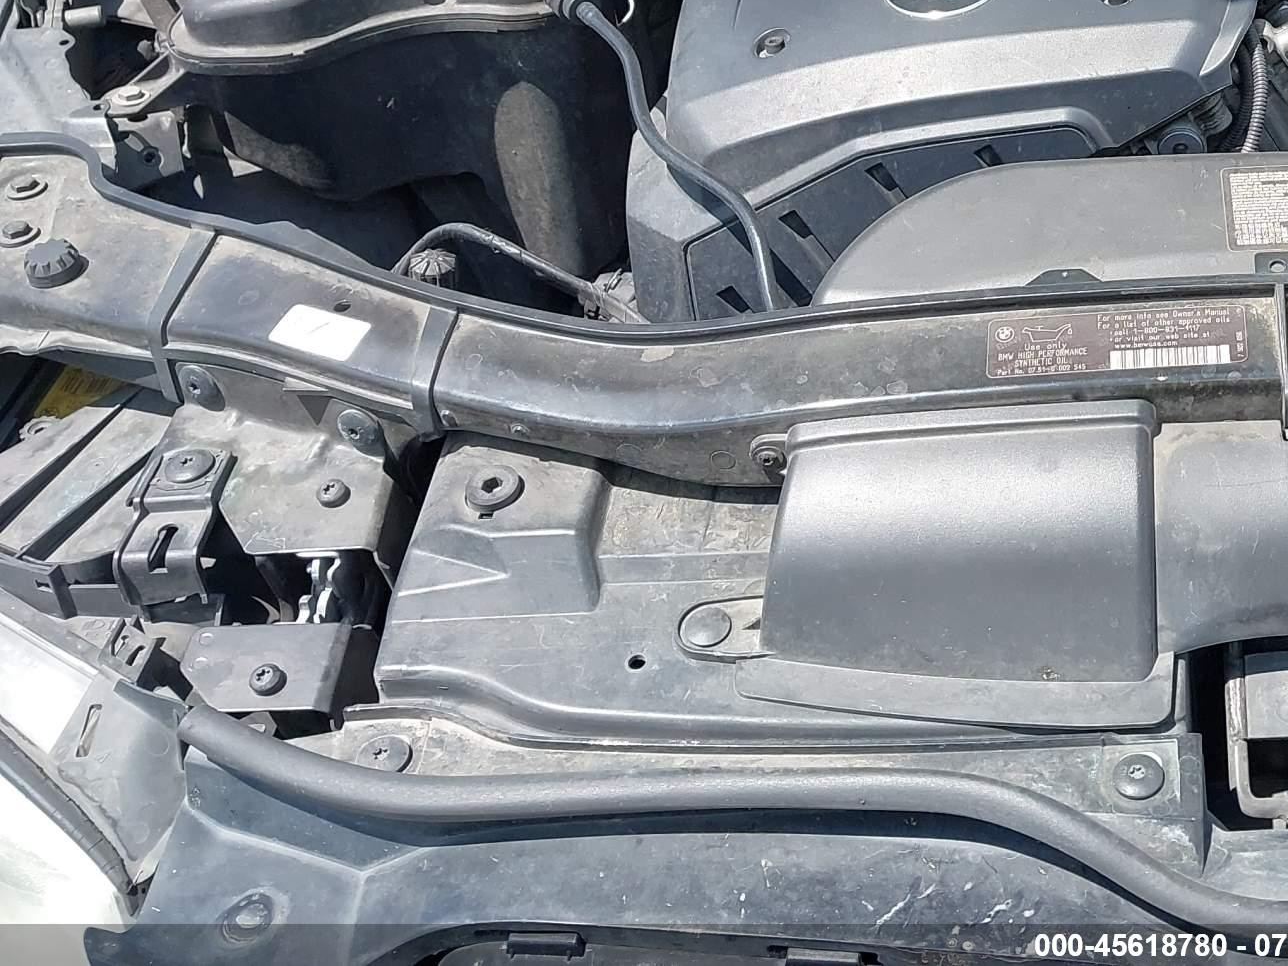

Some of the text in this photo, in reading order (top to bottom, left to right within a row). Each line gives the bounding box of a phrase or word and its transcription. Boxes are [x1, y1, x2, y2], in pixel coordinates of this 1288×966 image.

[1097, 314, 1110, 322] For
[1172, 309, 1201, 318] Owner's
[1097, 322, 1110, 330] For
[1124, 320, 1136, 328] list
[1155, 318, 1174, 326] other
[1178, 317, 1212, 325] approved
[1166, 332, 1179, 340] web
[1184, 331, 1198, 339] site
[1047, 341, 1067, 349] only
[998, 347, 1088, 361] BMW HIGH PERFORMANCE
[1014, 358, 1052, 367] SYNTHETIC
